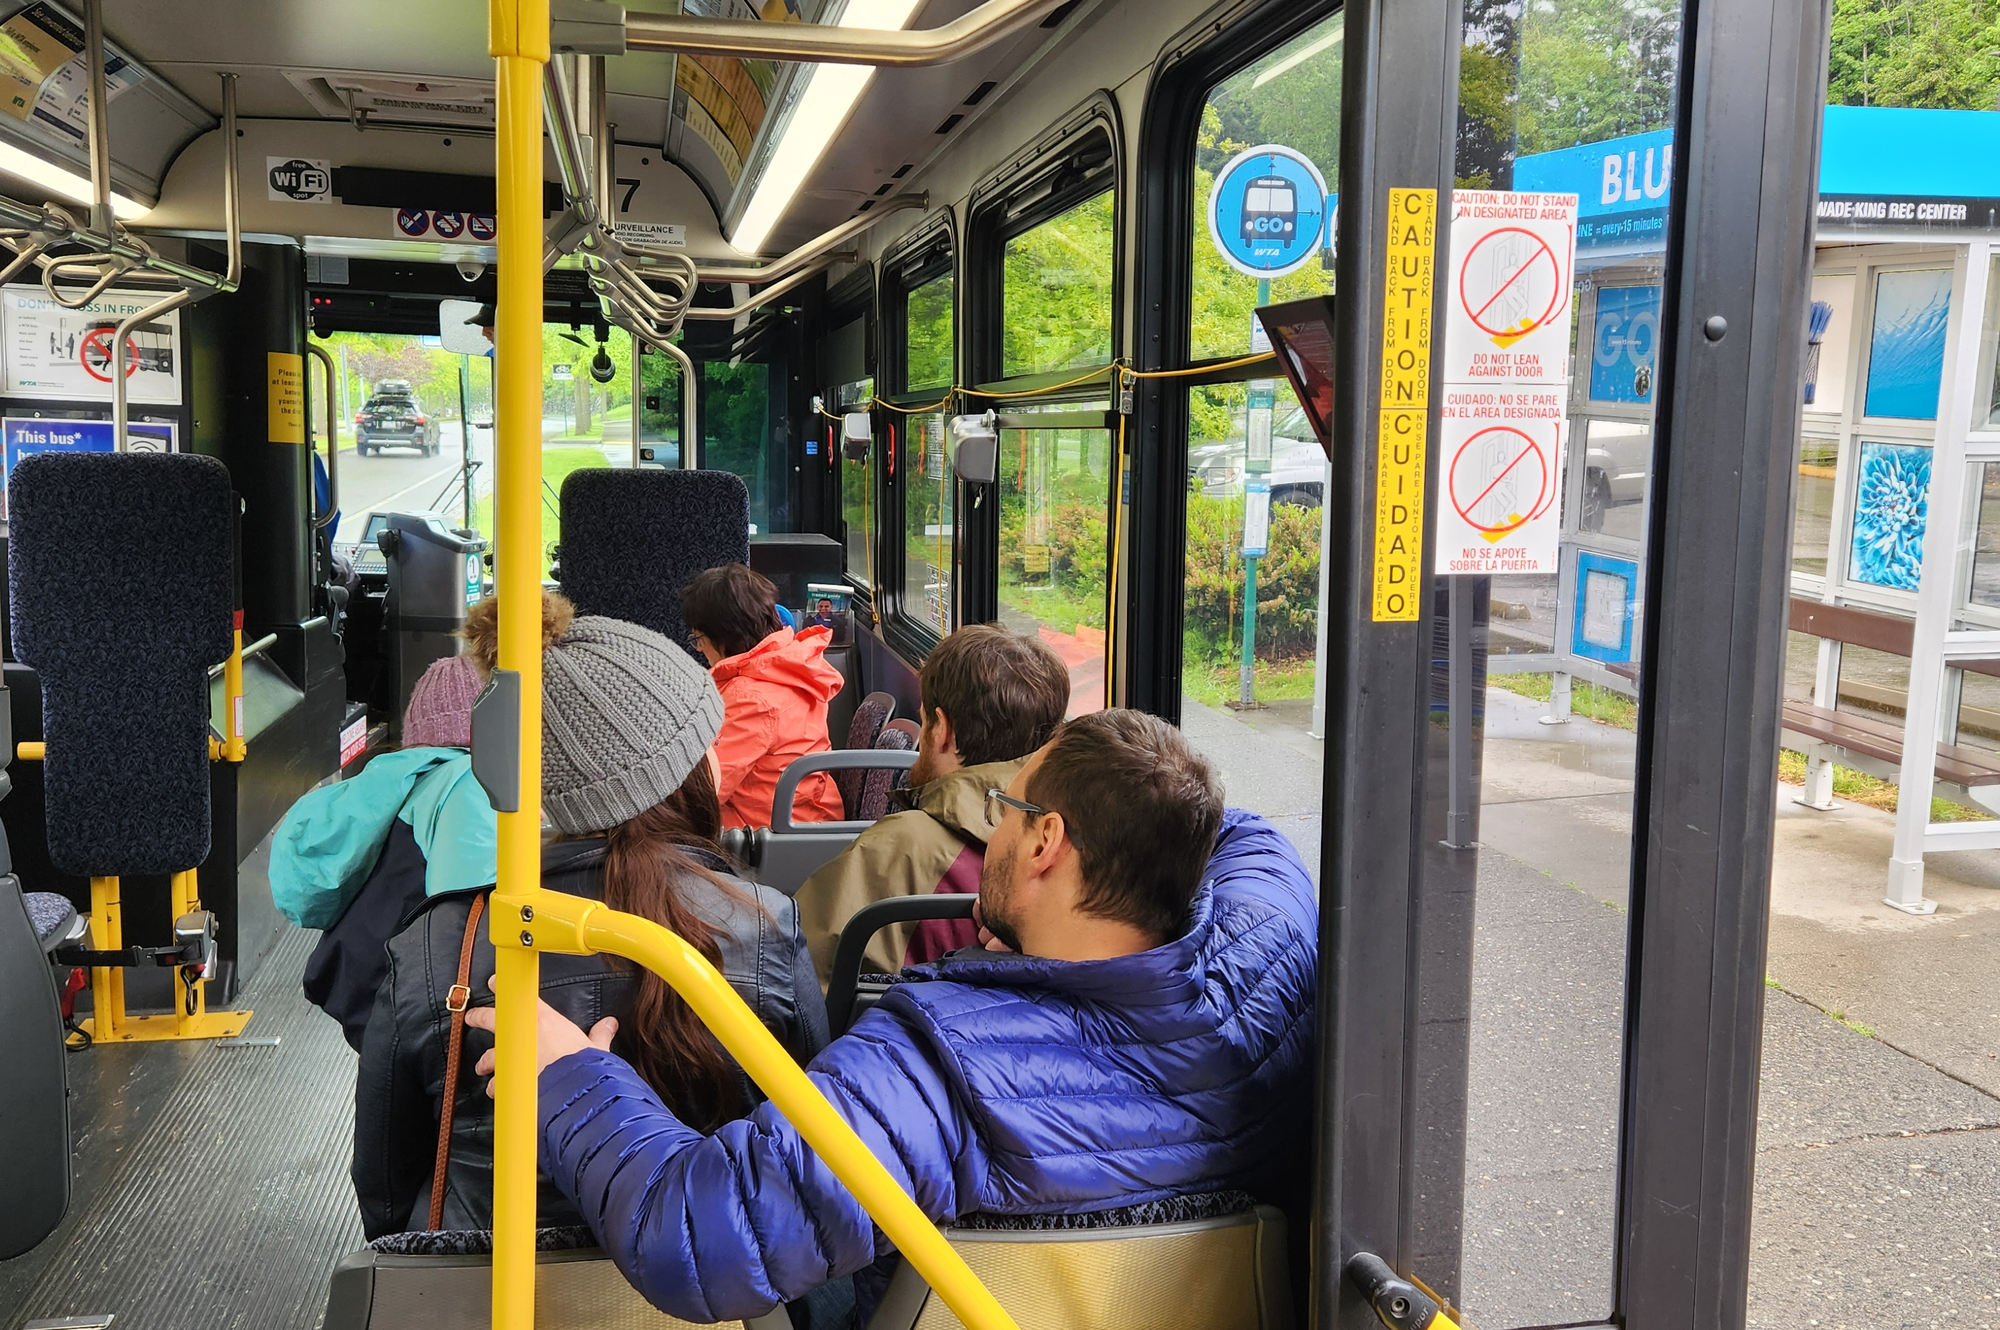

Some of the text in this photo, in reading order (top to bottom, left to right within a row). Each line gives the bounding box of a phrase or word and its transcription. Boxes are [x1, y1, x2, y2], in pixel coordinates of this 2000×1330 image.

[1600, 144, 1673, 205] BLU
[292, 192, 308, 200] spot
[1452, 192, 1576, 207] CAUTION: DO NOT STAND
[1460, 206, 1568, 220] IN DESIGNATED AREA
[1888, 203, 1915, 219] REC
[1916, 204, 1967, 220] CENTER
[614, 222, 674, 234] URVEILLANCE
[1254, 217, 1284, 233] GO
[1633, 216, 1663, 232] minutes
[1254, 248, 1280, 256] WTA
[1384, 194, 1400, 400] STAND BACK FROM DOOR
[1396, 193, 1422, 400] CAUTION
[1416, 194, 1433, 400] STAND BACK FROM DOOR
[104, 304, 116, 314] IN
[1594, 311, 1659, 368] GO
[1474, 354, 1540, 365] DO NOT LEAN
[1468, 366, 1543, 378] AGAINST DOOR
[1448, 393, 1558, 406] CUIDADO: NO SE PARE
[1442, 406, 1561, 419] EN EL AREA DESIGNADA
[1382, 414, 1390, 431] NO
[1416, 414, 1422, 431] NO
[16, 430, 46, 444] This
[1382, 434, 1389, 451] SE
[1416, 434, 1422, 451] SE
[1379, 490, 1387, 534] JUNTO
[1386, 414, 1412, 614] CUIDADO
[1378, 548, 1384, 564] LA
[1410, 548, 1417, 563] LA
[1462, 548, 1527, 559] NO SE APOYE
[1450, 560, 1482, 571] SOBRE
[1485, 560, 1498, 571] LA
[1500, 560, 1538, 571] PUERTA
[1376, 566, 1384, 618] PUERTA
[1408, 566, 1416, 618] PUERTA
